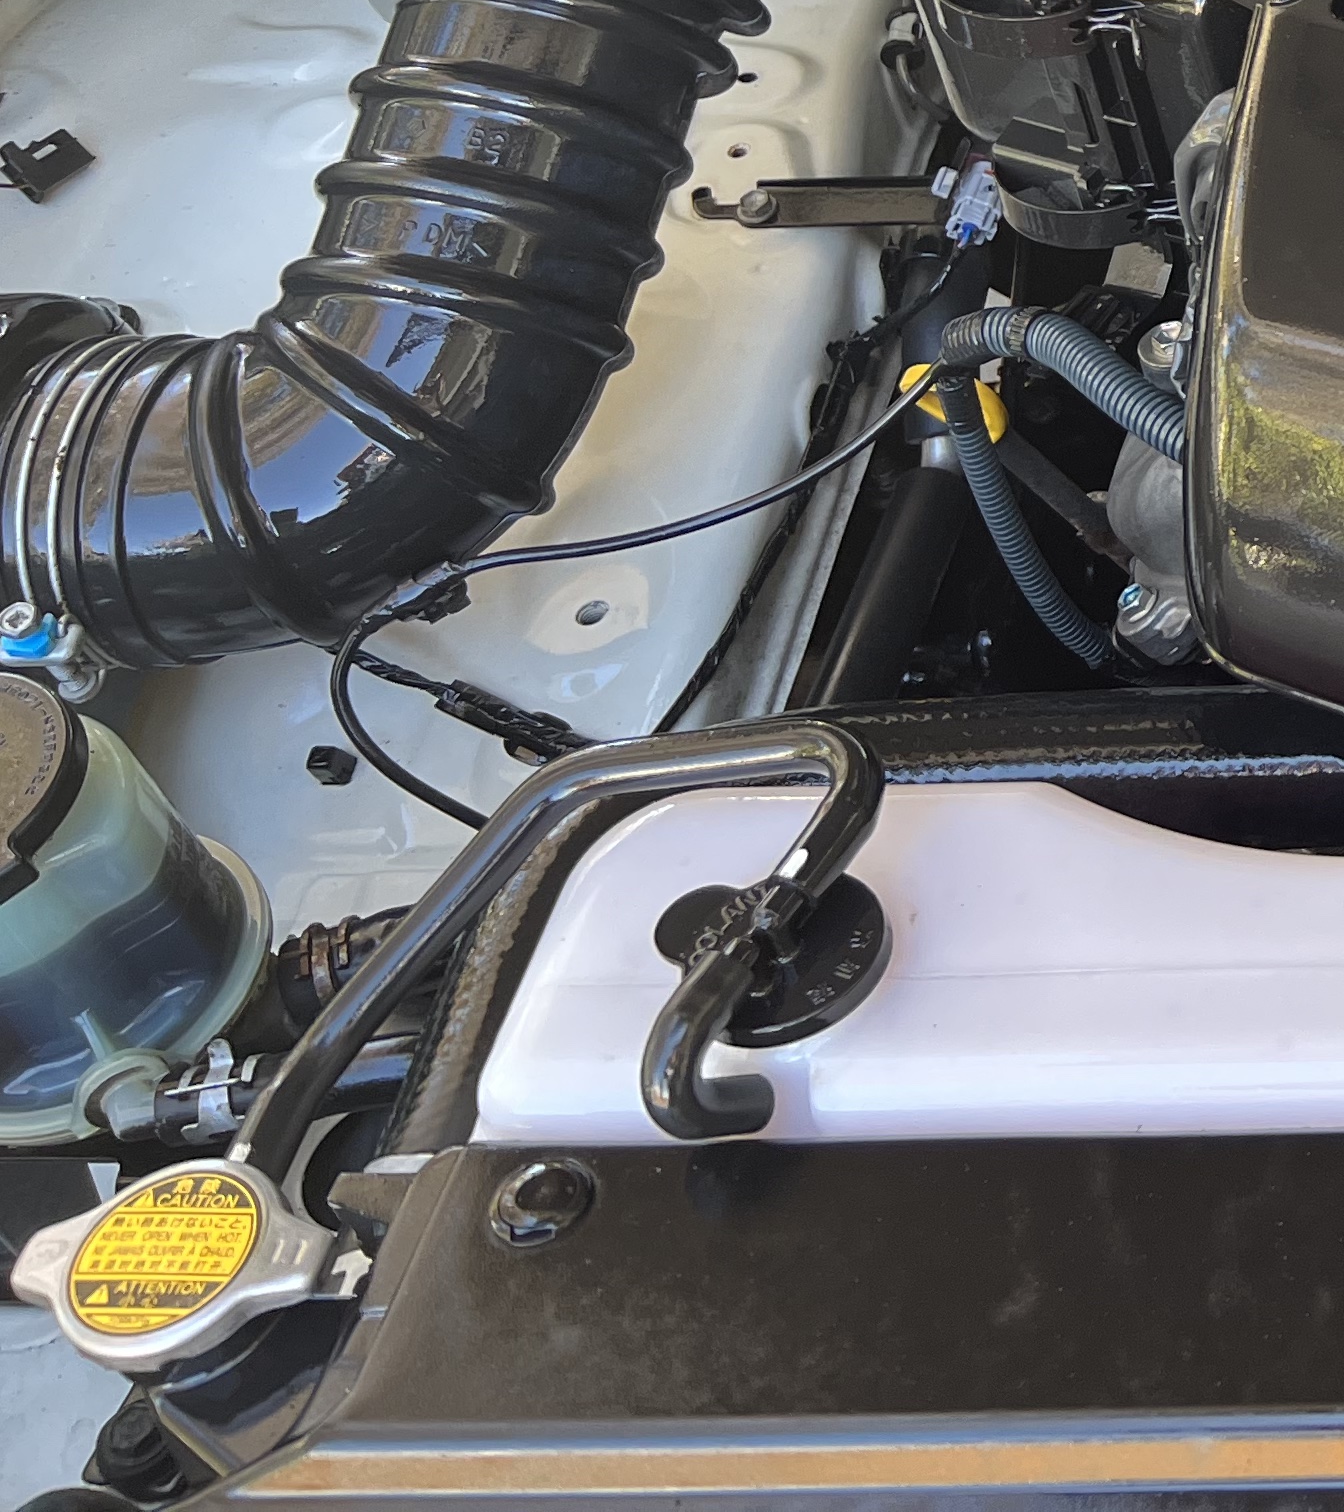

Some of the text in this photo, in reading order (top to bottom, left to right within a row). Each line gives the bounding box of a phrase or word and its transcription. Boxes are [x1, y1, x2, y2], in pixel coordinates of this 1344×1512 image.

[156, 1193, 240, 1208] CAUTION
[100, 1231, 136, 1242] NEVER
[142, 1231, 173, 1242] OPEN
[114, 1280, 207, 1296] ATTENTION
